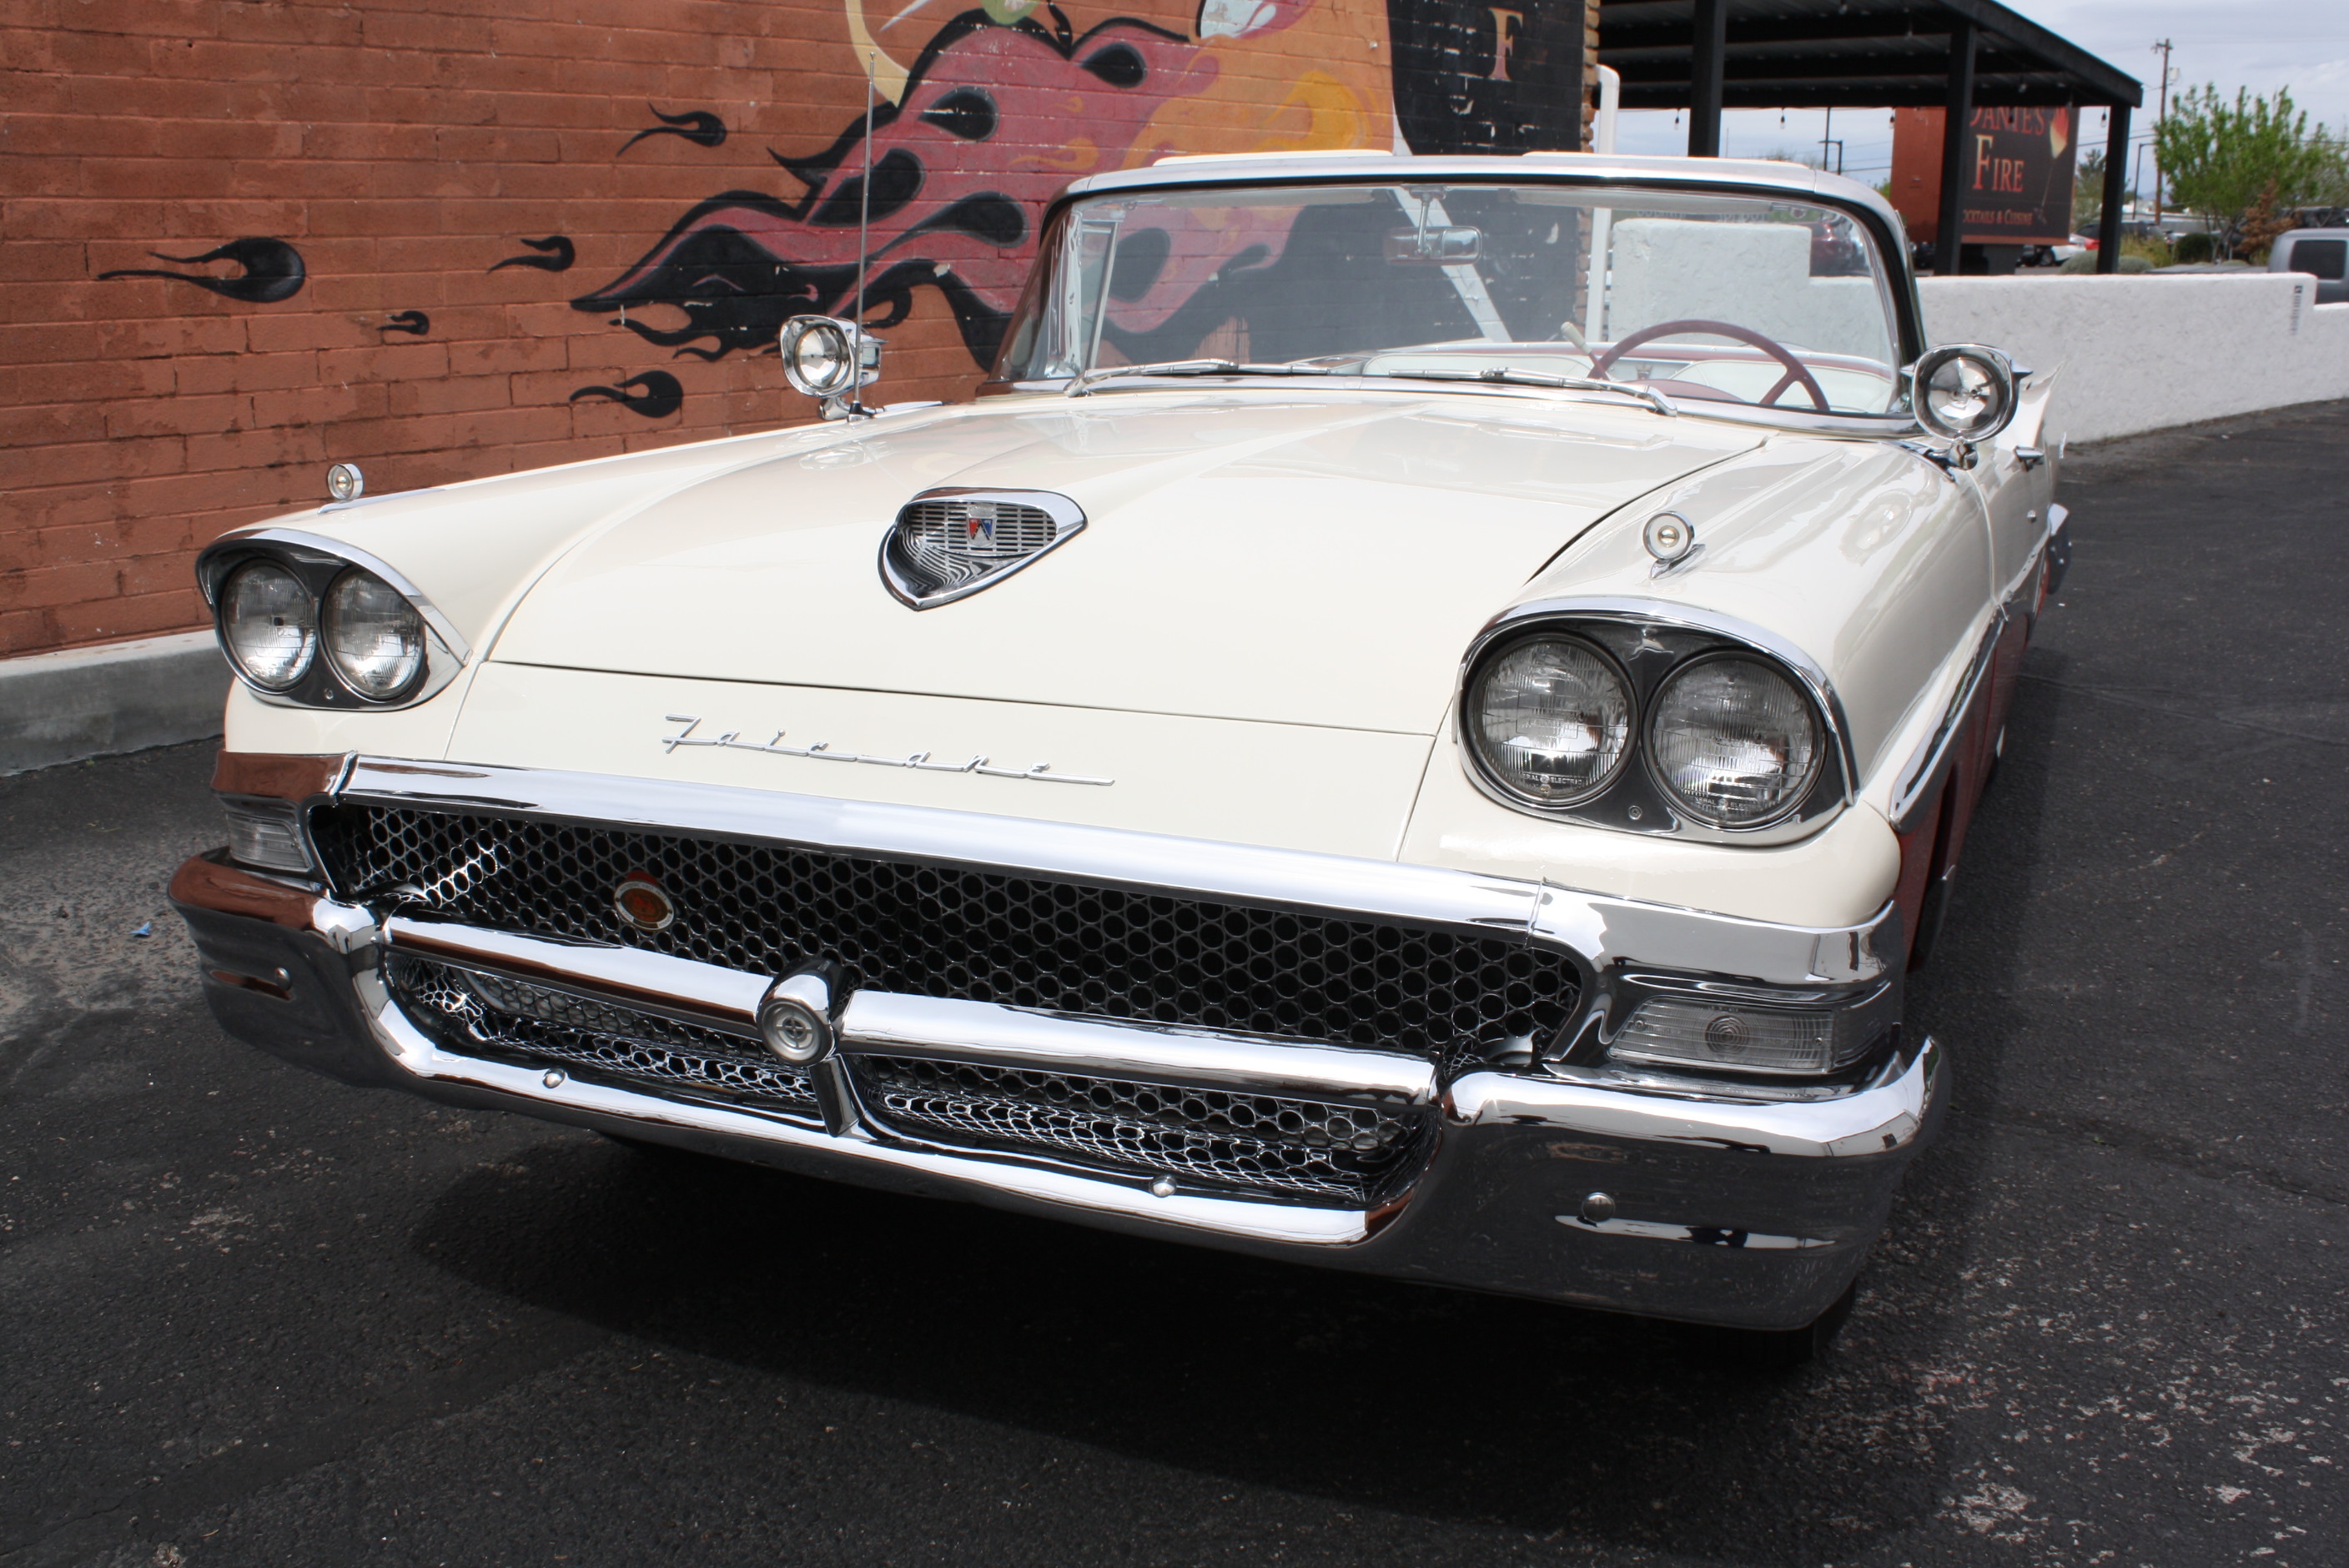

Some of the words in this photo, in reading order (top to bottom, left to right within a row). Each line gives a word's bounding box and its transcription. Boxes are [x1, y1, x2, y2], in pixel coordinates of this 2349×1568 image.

[1488, 7, 1524, 81] F
[1973, 134, 2025, 193] FIRE
[661, 713, 1116, 787] Fairane
